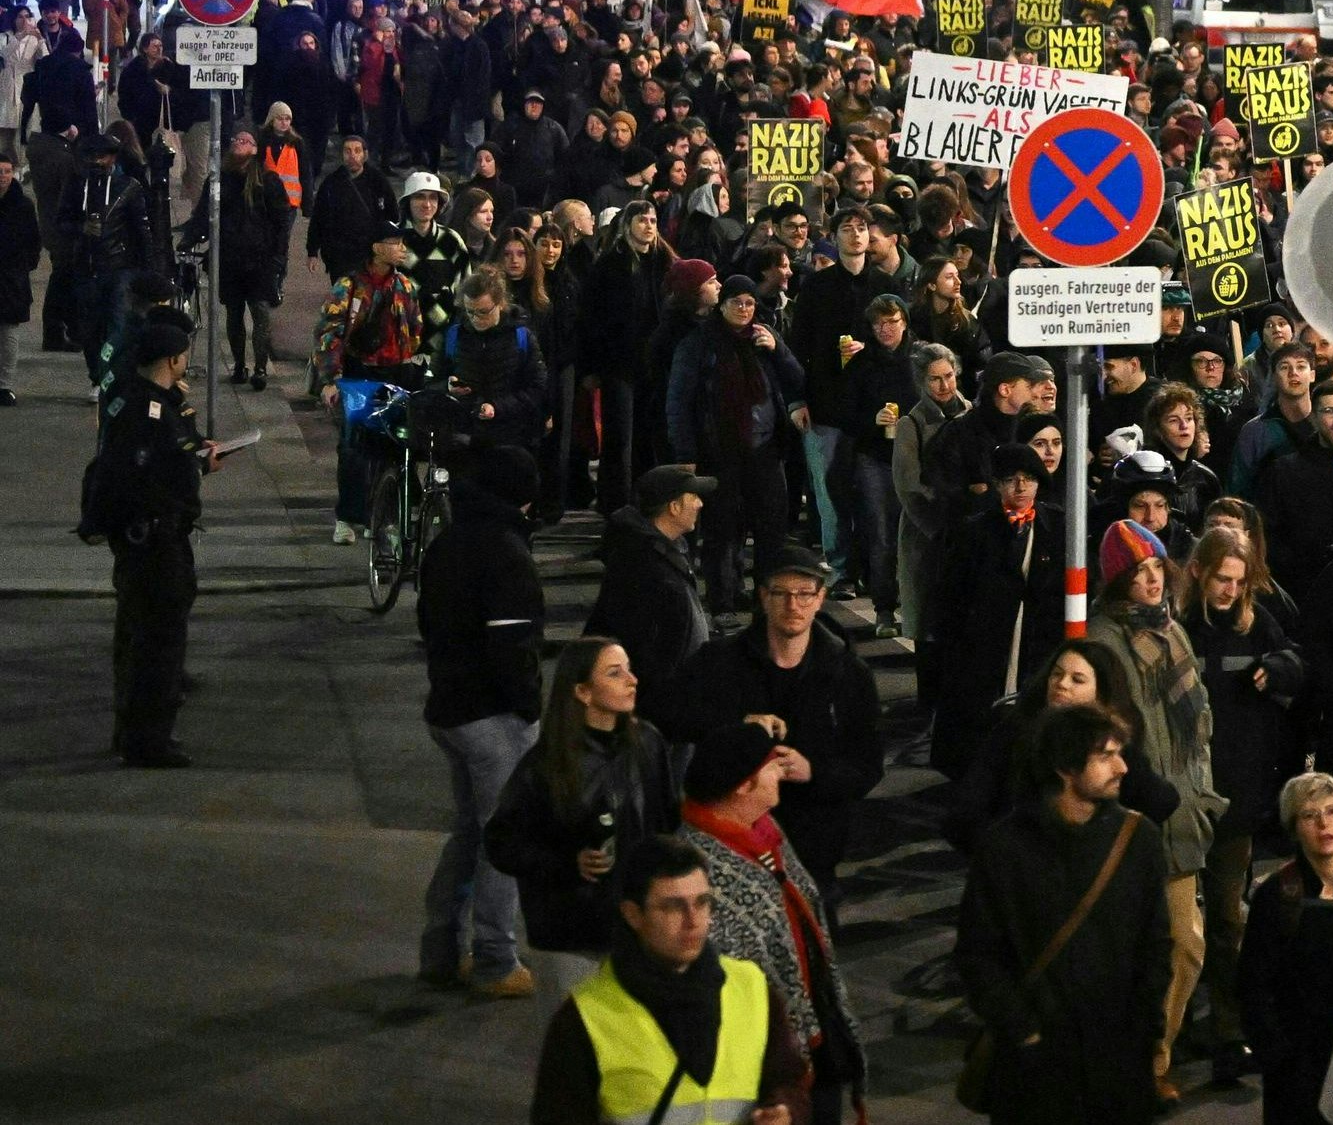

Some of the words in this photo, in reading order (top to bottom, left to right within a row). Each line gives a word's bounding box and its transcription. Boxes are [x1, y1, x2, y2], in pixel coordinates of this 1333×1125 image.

[939, 12, 985, 32] RAUS
[1016, 3, 1062, 23] RAUS
[753, 26, 775, 41] AZI
[1049, 26, 1102, 48] NAZIS
[212, 40, 254, 51] Fahrzeuge
[1226, 45, 1283, 66] NAZIS
[198, 53, 211, 62] der
[215, 53, 235, 62] OPEC
[1050, 46, 1103, 68] RAUS
[195, 68, 238, 86] Anfang
[976, 60, 1061, 90] LIEBER
[1248, 65, 1309, 95] NAZIS
[911, 75, 1036, 110] LINKS-GRÜN
[1251, 87, 1311, 119] RAUS
[983, 107, 1033, 135] ALS
[751, 123, 820, 148] NAZIS
[903, 121, 1003, 166] BLAUER
[751, 147, 820, 175] RAUS
[1179, 182, 1252, 228] NAZIS
[1184, 212, 1257, 261] RAUS
[1015, 283, 1063, 298] ausgen.
[1067, 280, 1131, 296] Fahrzeuge
[1135, 279, 1156, 293] der
[1017, 300, 1081, 317] Ständigen
[1085, 300, 1154, 316] Vertretung
[1040, 322, 1063, 335] von
[1068, 319, 1131, 335] Rumänien
